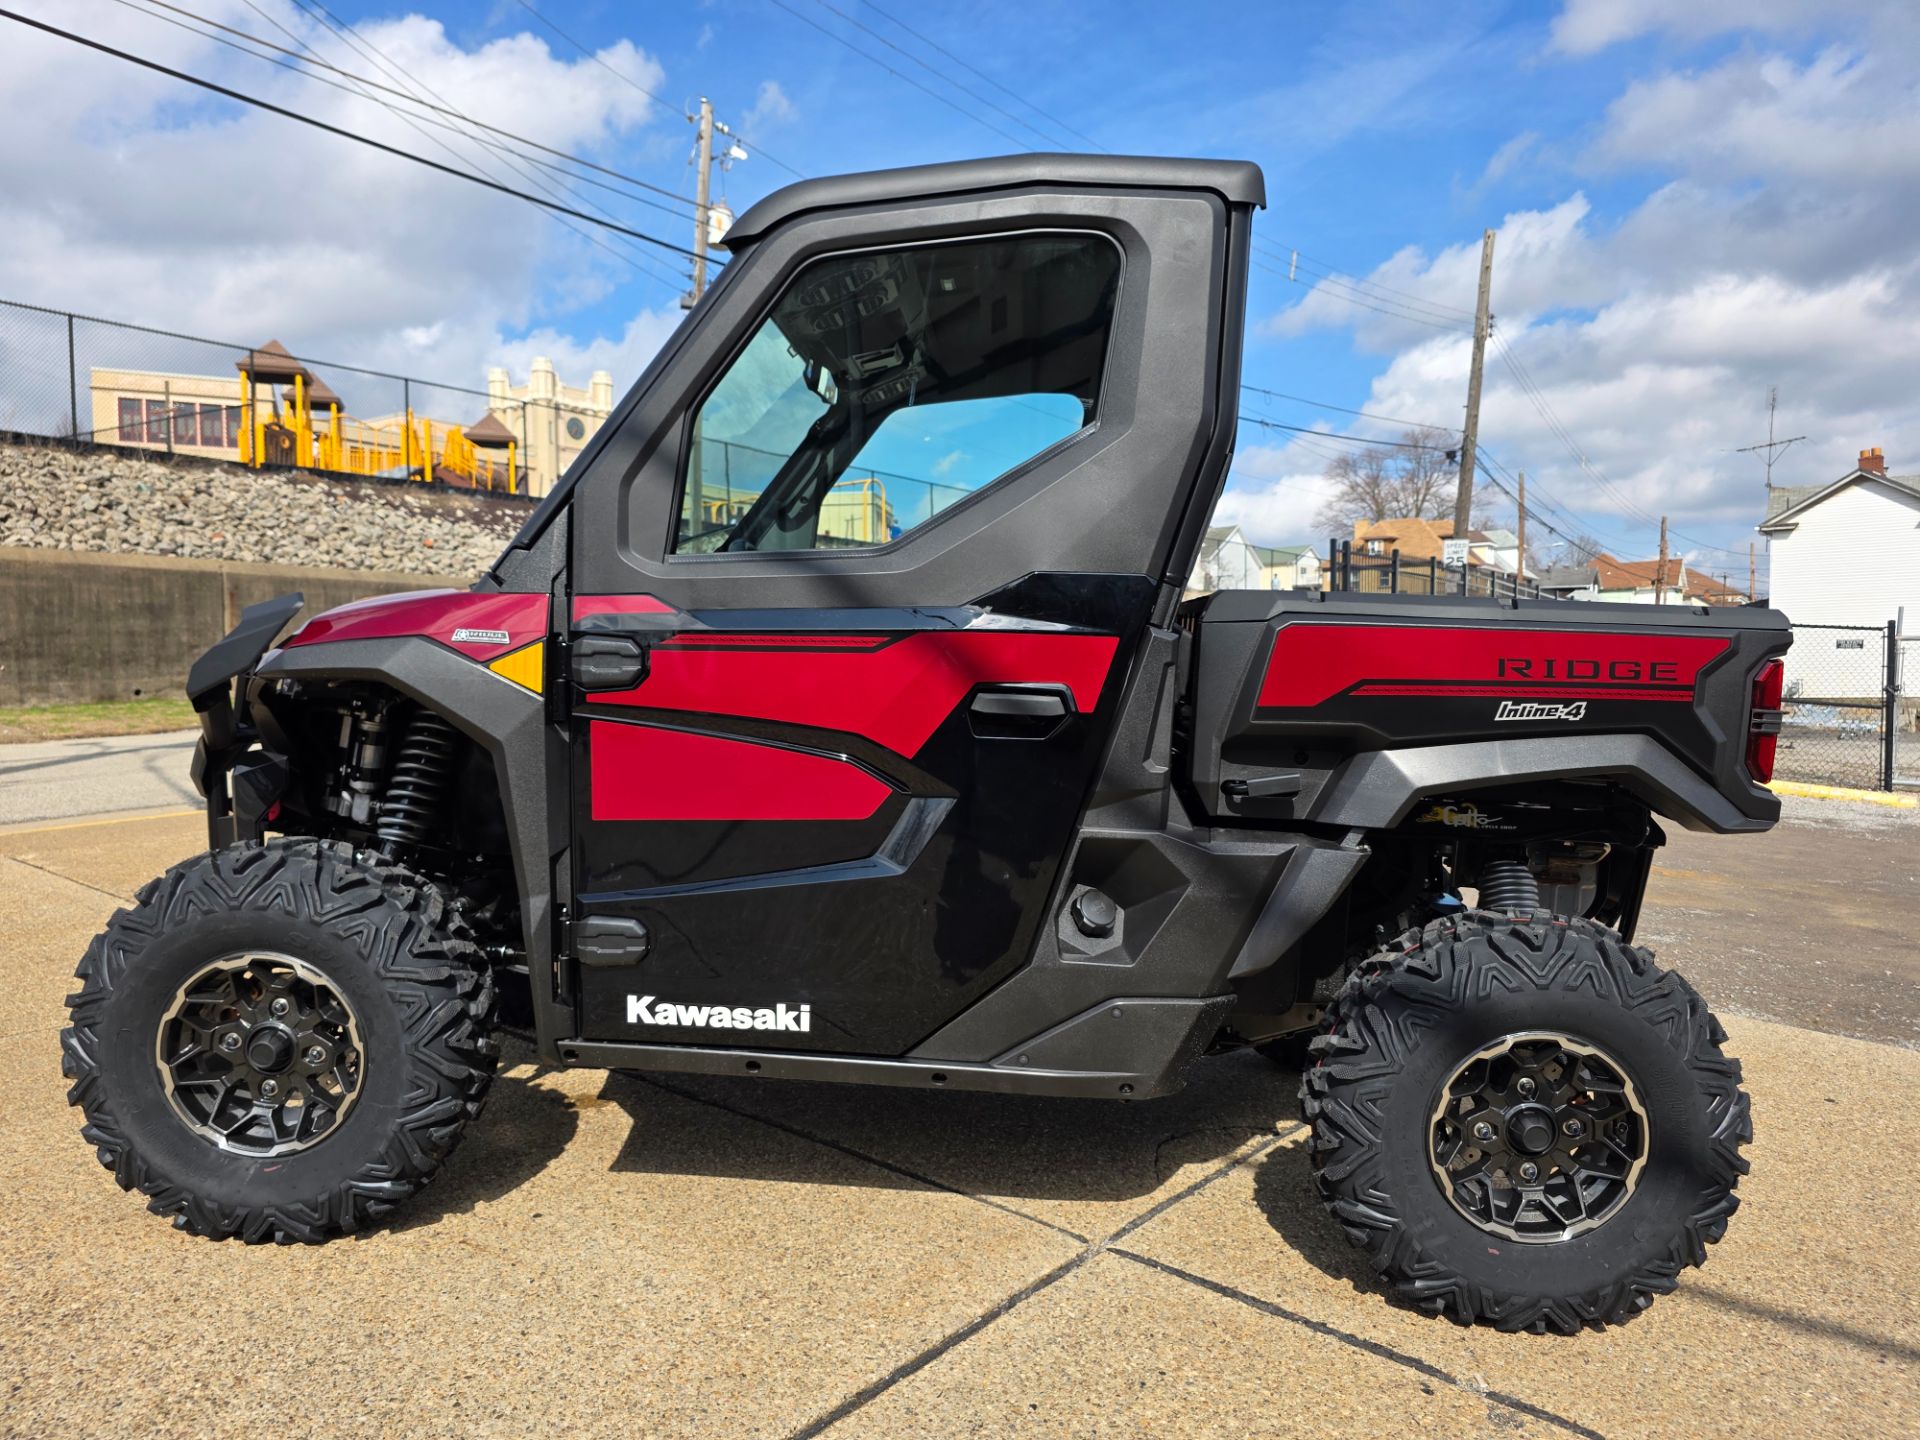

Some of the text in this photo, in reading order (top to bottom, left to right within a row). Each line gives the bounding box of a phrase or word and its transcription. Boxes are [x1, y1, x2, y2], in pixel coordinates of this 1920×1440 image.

[1445, 556, 1465, 568] 25
[1498, 658, 1679, 682] RIDGE
[1494, 701, 1588, 721] Inline-4
[626, 994, 811, 1032] Kawasaki
